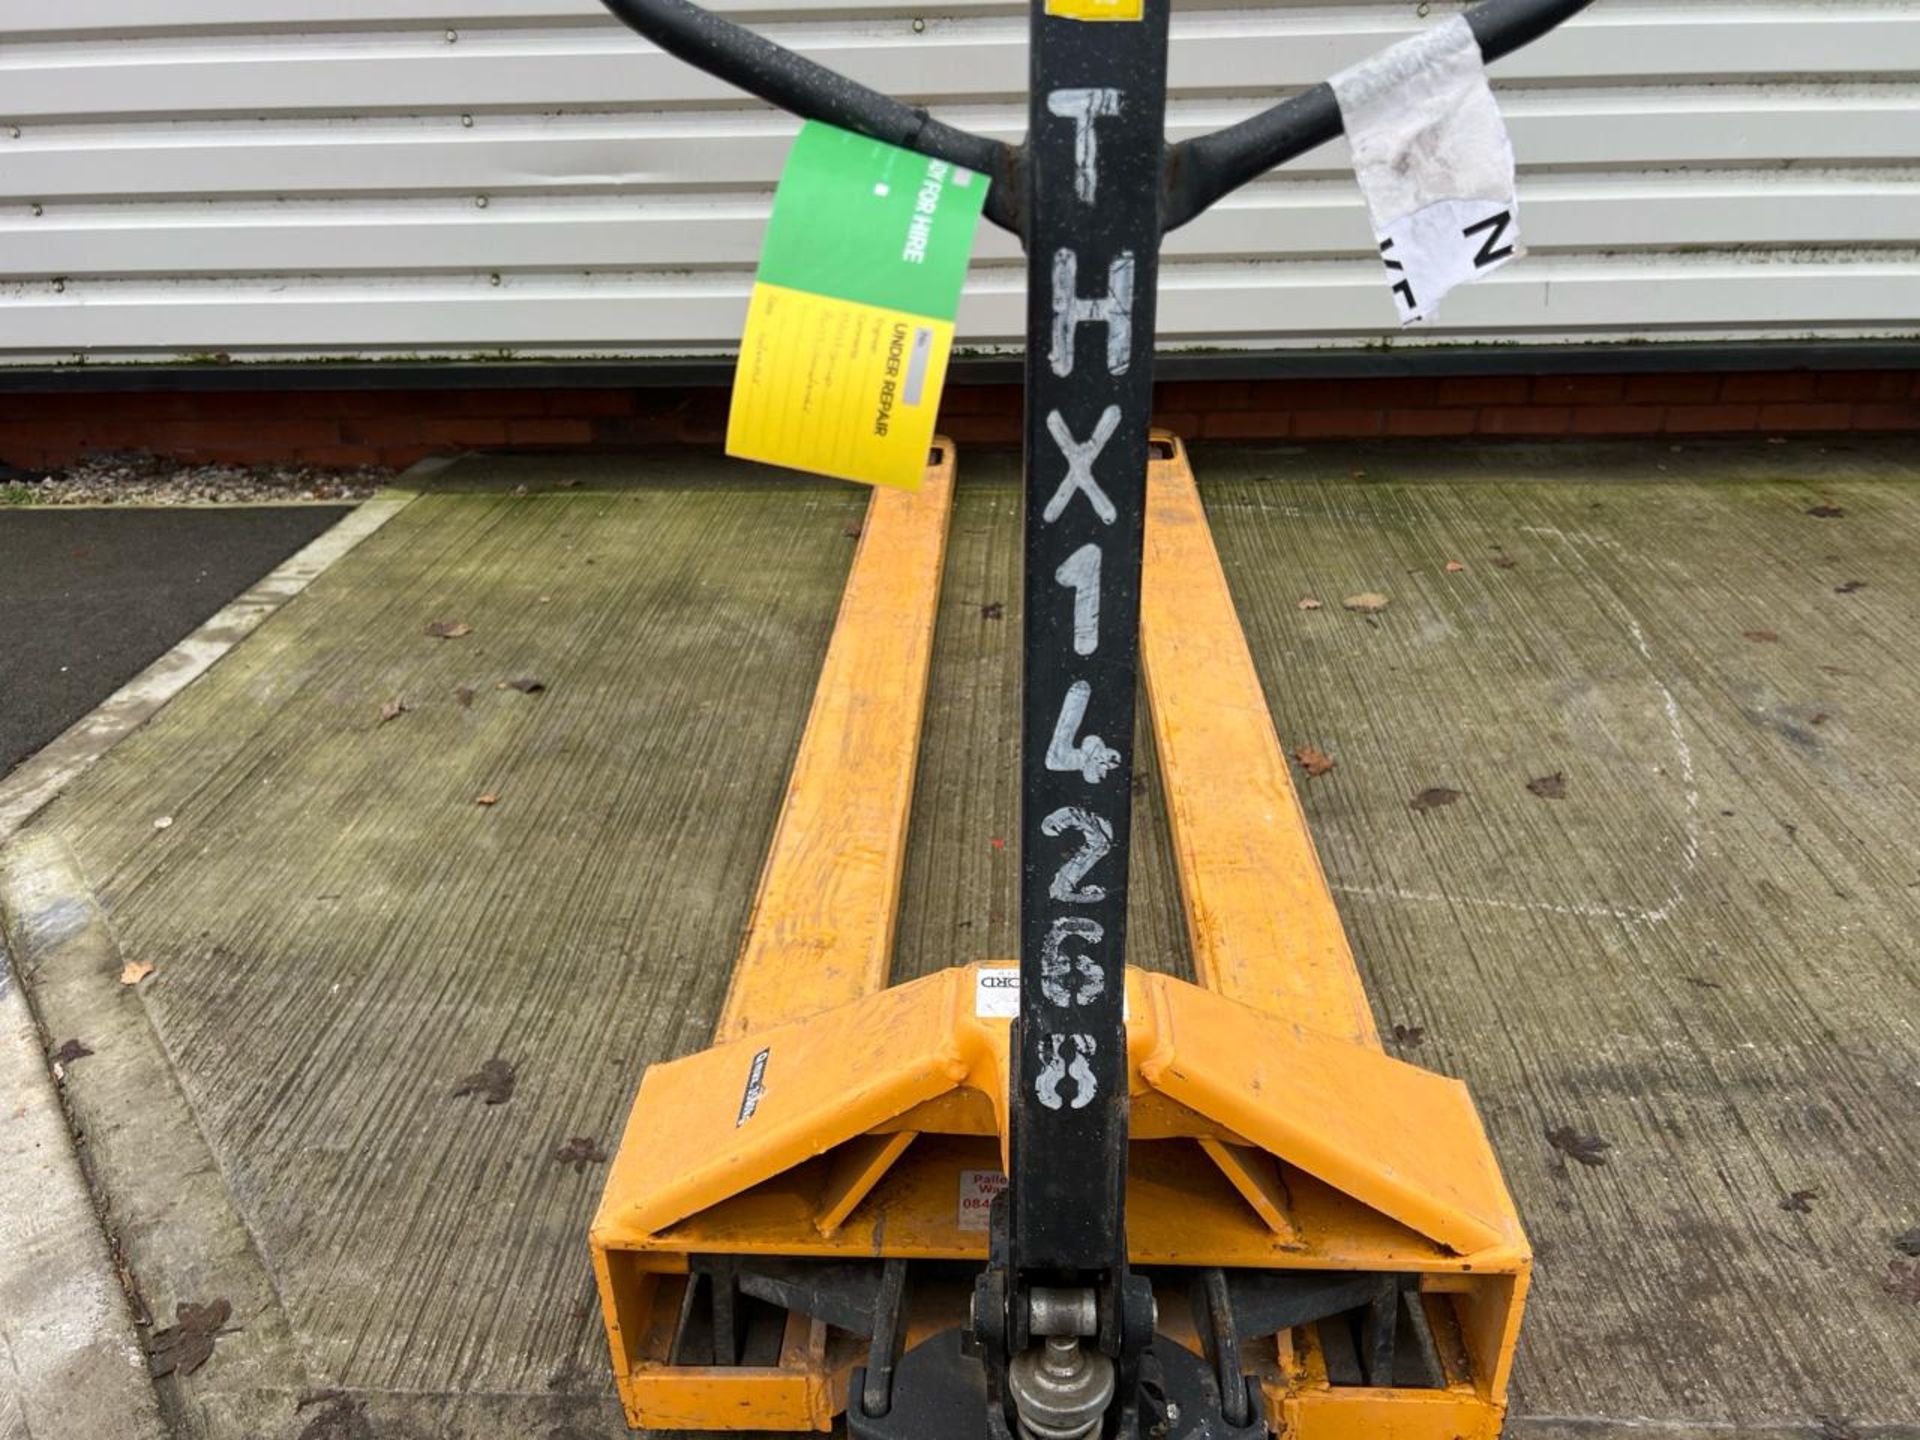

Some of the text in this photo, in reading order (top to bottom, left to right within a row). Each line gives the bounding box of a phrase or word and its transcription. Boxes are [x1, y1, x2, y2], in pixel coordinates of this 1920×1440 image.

[914, 178, 943, 214] FOR
[902, 213, 934, 264] HIRE
[873, 322, 909, 438] UNDER REPAIR
[980, 976, 1021, 988] ORD
[974, 1174, 1008, 1185] Palle
[962, 1198, 991, 1209] 084
